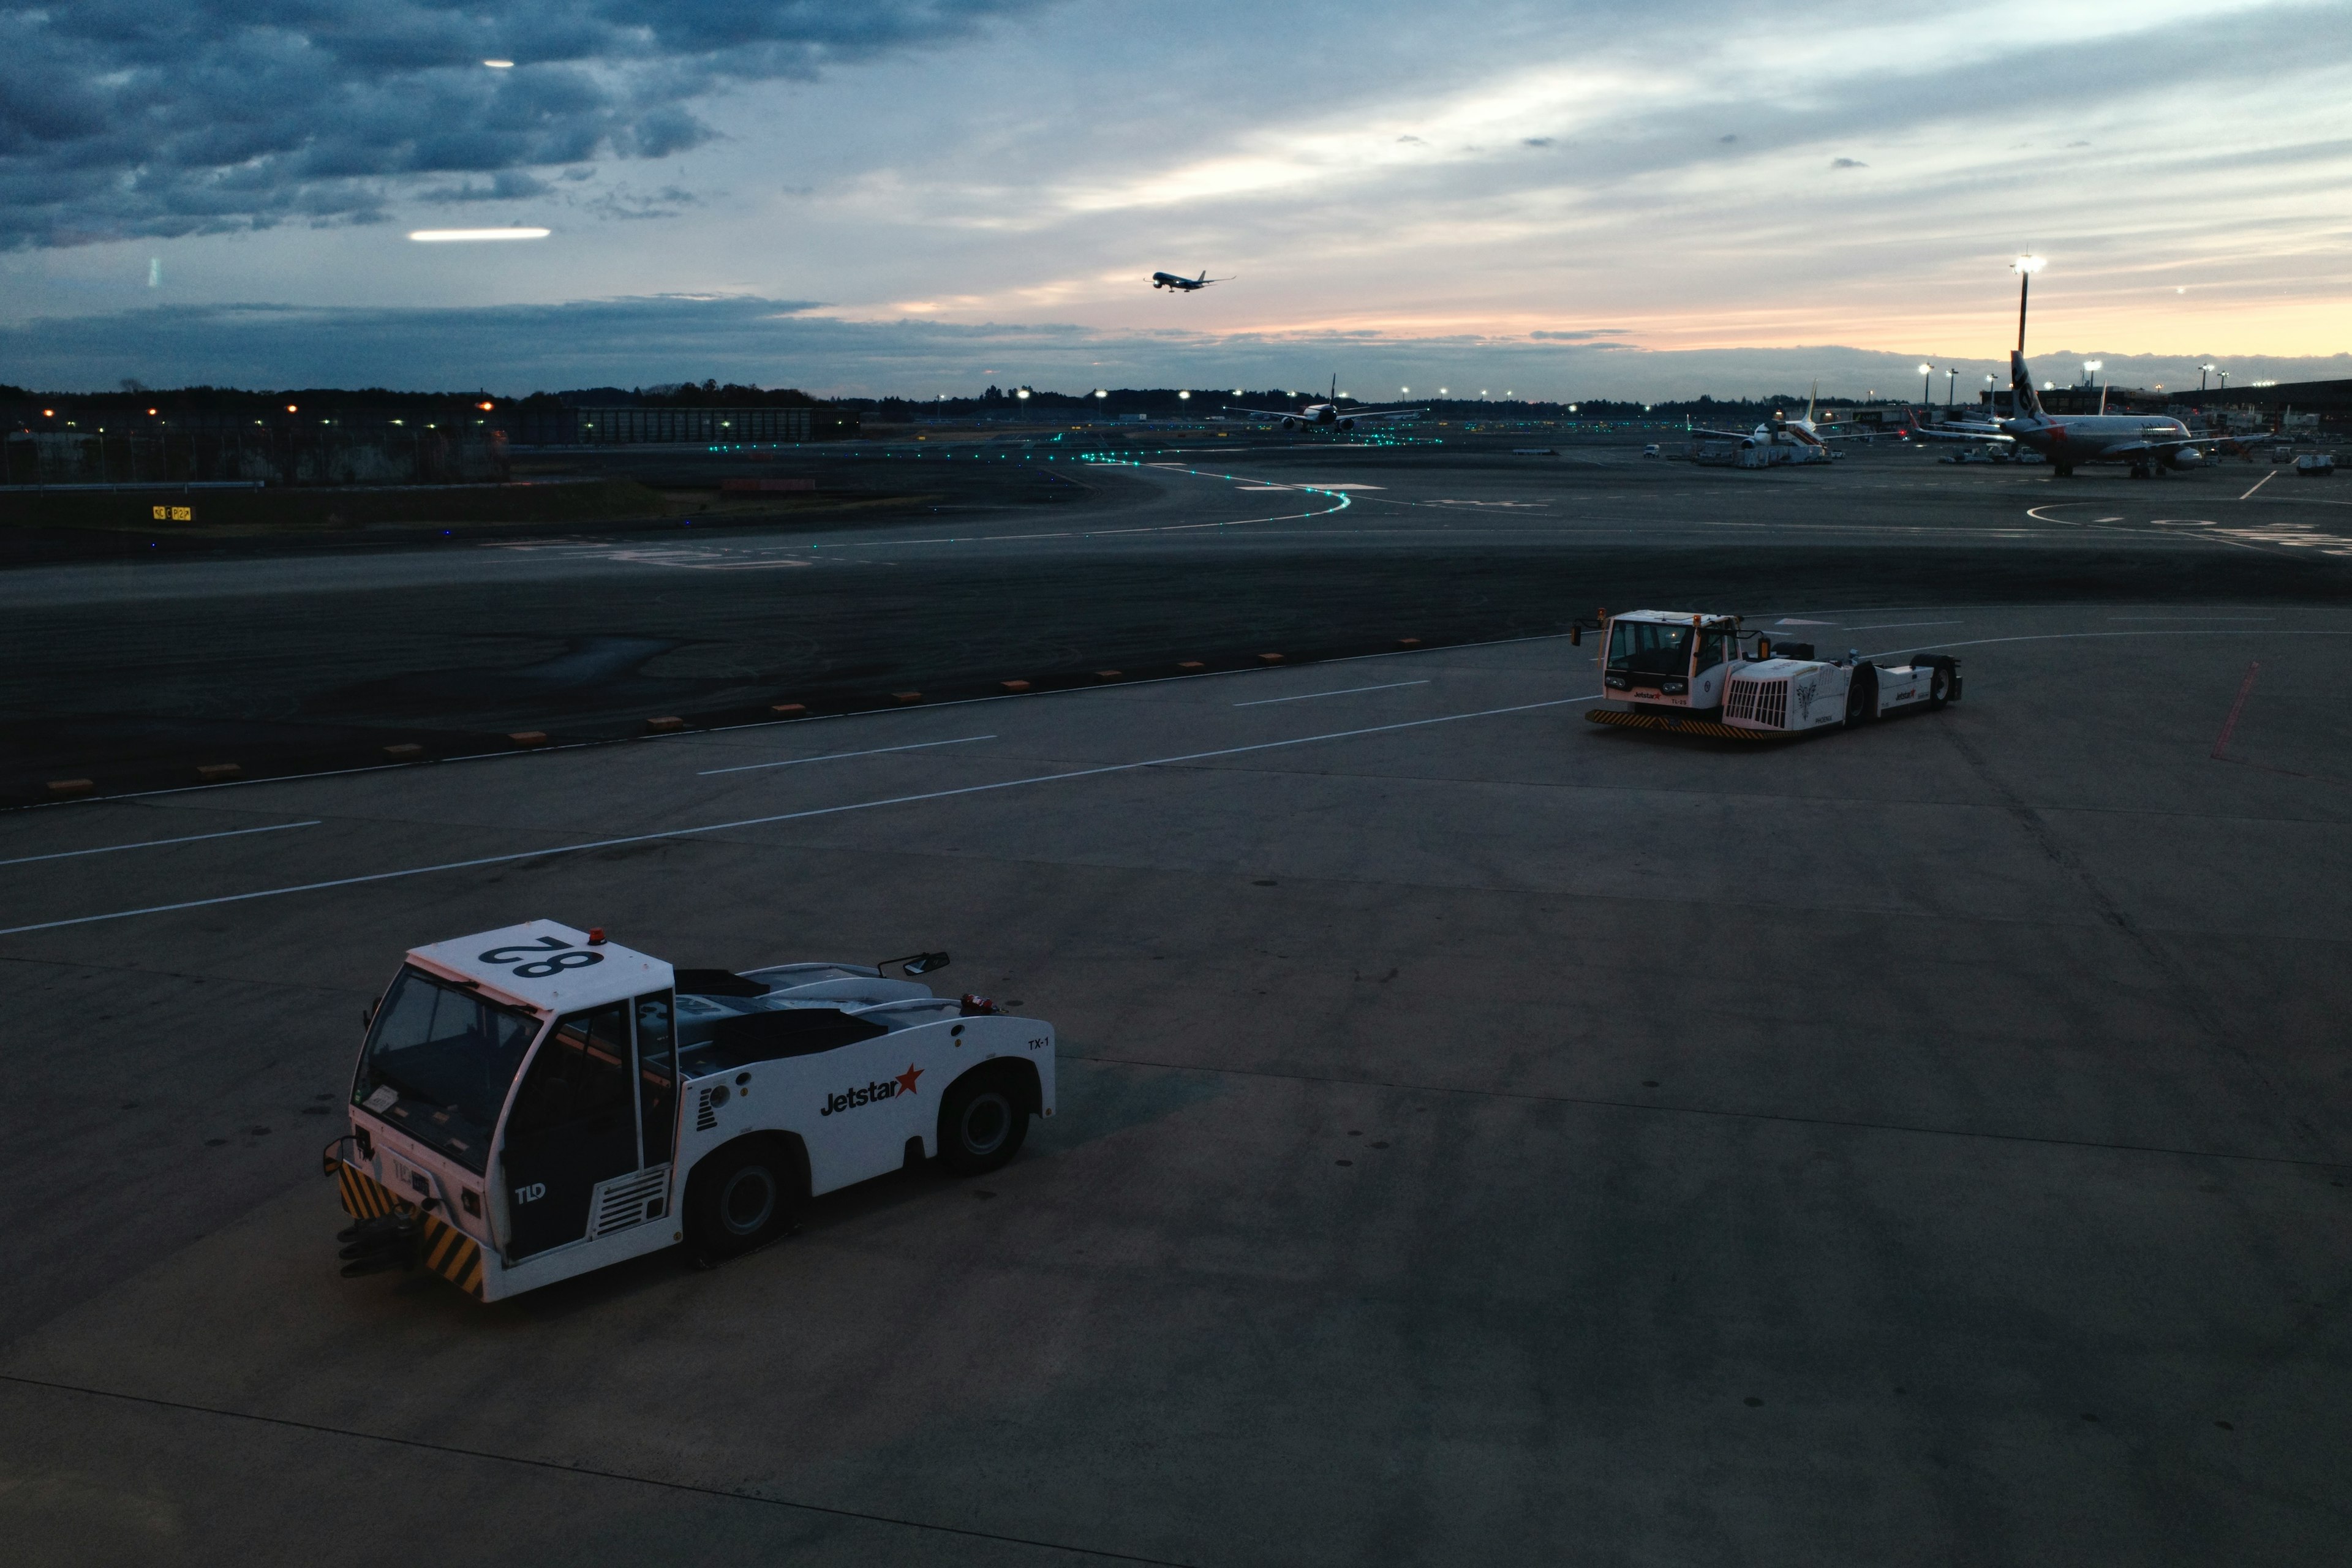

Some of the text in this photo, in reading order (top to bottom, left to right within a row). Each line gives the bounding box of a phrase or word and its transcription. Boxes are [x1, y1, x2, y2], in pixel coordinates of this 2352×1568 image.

[159, 508, 164, 518] C
[1028, 1036, 1048, 1050] TX-1
[821, 1081, 899, 1116] Jetstar
[515, 1183, 546, 1205] TLD
